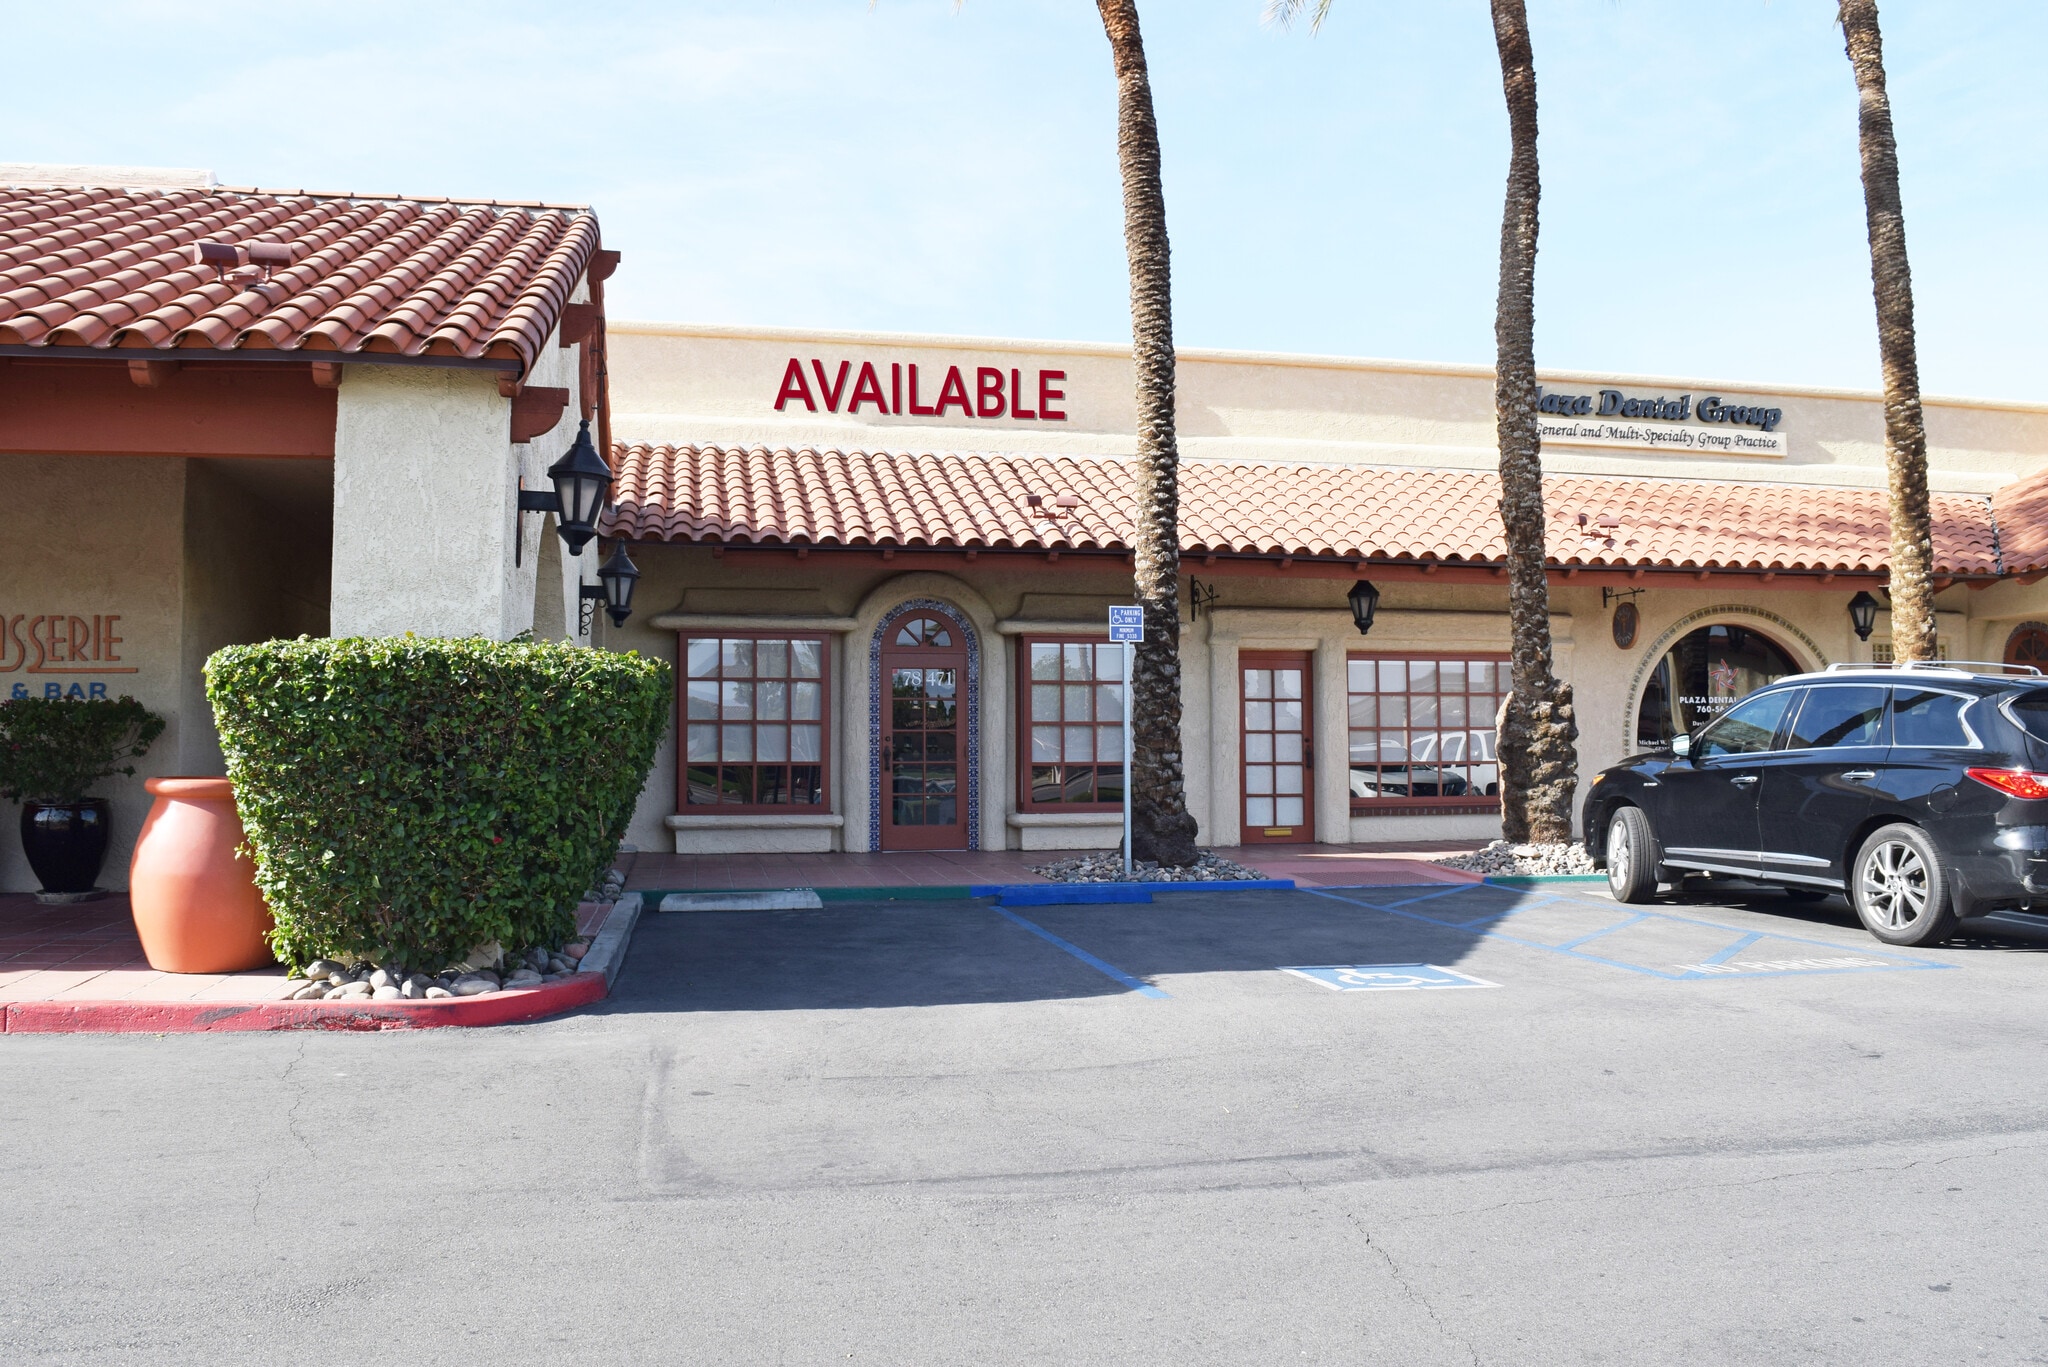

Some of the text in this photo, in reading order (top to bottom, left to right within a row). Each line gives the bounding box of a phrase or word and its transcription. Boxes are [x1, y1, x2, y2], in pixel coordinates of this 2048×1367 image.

[774, 358, 1067, 421] AVAILABLE
[1535, 386, 1783, 432] laza Dental Group
[1581, 425, 1605, 439] and
[1606, 426, 1695, 447] Multi-Specialty
[1698, 432, 1731, 450] Group
[1734, 434, 1778, 449] Practice
[0, 614, 124, 674] SSERIE
[903, 671, 953, 687] 78 471
[11, 682, 107, 700] & BAR
[1679, 696, 1707, 704] PLAZA
[1696, 705, 1728, 713] 760-56
